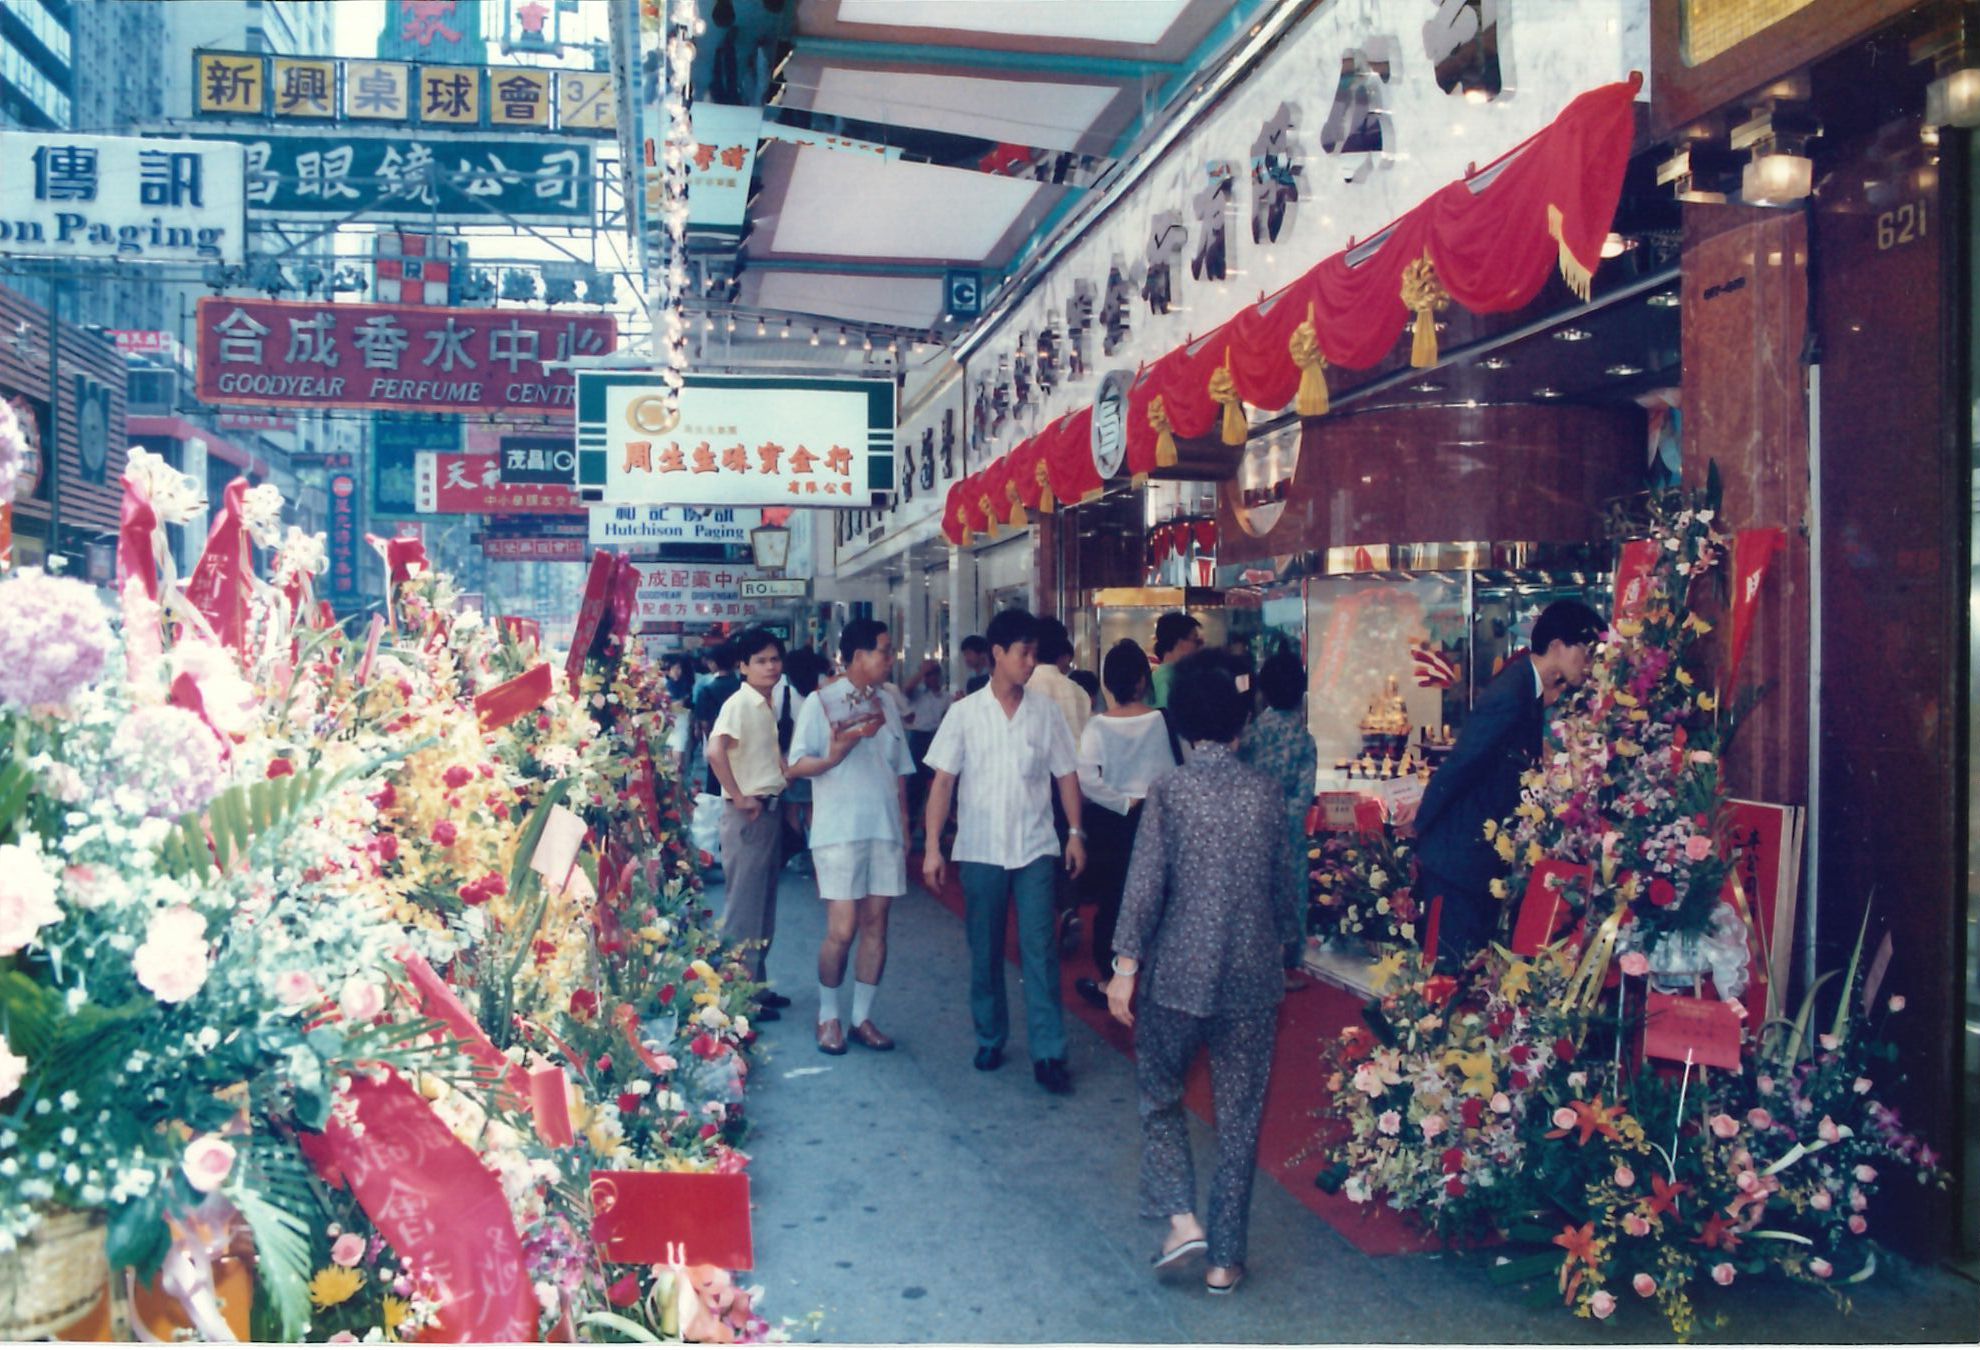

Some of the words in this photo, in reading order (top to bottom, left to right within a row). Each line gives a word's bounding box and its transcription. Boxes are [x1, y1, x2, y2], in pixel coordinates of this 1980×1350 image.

[206, 59, 542, 120] 新興桌球會
[31, 145, 203, 208] 傳訊
[55, 212, 226, 256] Paging
[1877, 199, 1927, 250] 621
[212, 307, 604, 375] 合成香水中心
[217, 373, 346, 398] GOODYEAR
[369, 377, 484, 402] PERFUME
[505, 449, 545, 471] 茂昌
[604, 523, 683, 537] Hutchison
[694, 525, 744, 539] Paging
